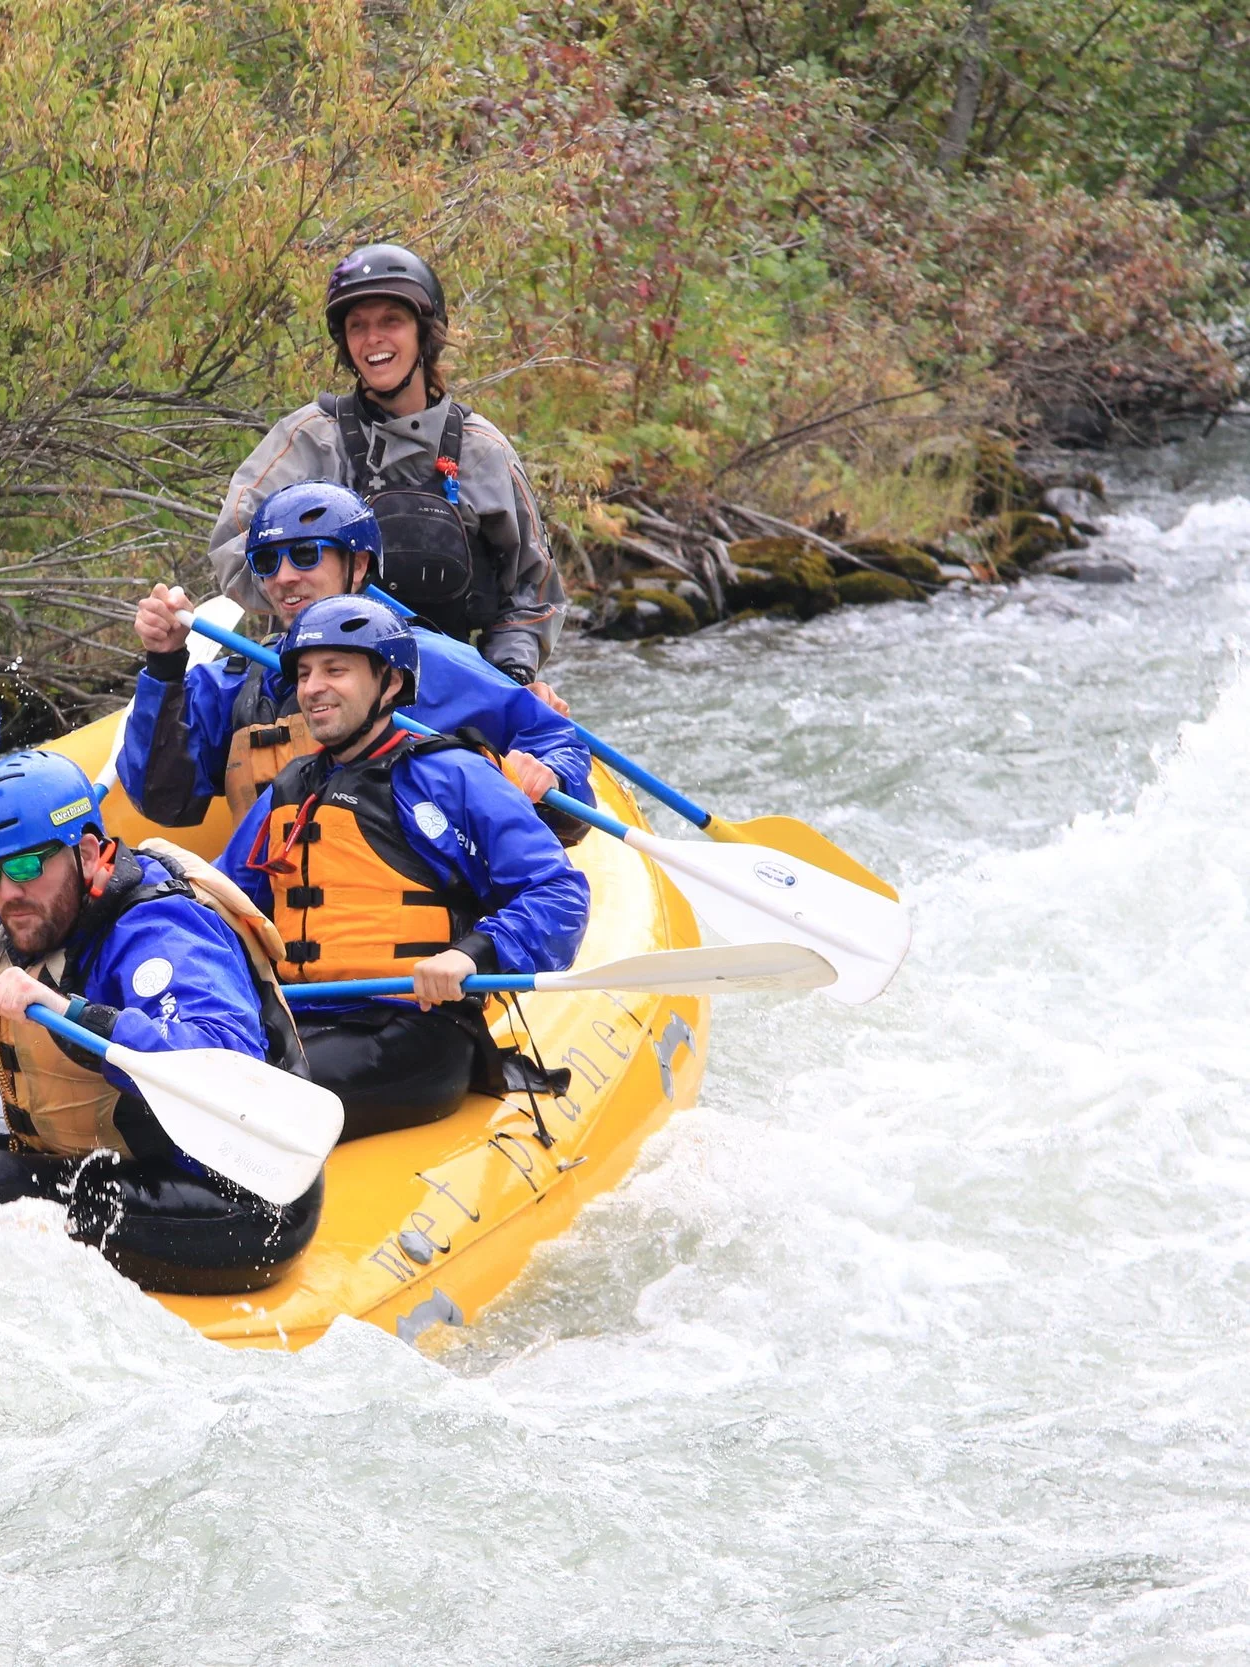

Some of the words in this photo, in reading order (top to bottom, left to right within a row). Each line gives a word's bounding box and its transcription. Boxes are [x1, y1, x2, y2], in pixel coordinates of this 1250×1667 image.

[418, 507, 450, 515] ASTRAL
[258, 527, 284, 539] NRS
[296, 632, 323, 642] NRS
[331, 792, 359, 805] NRS
[368, 1172, 480, 1282] wet
